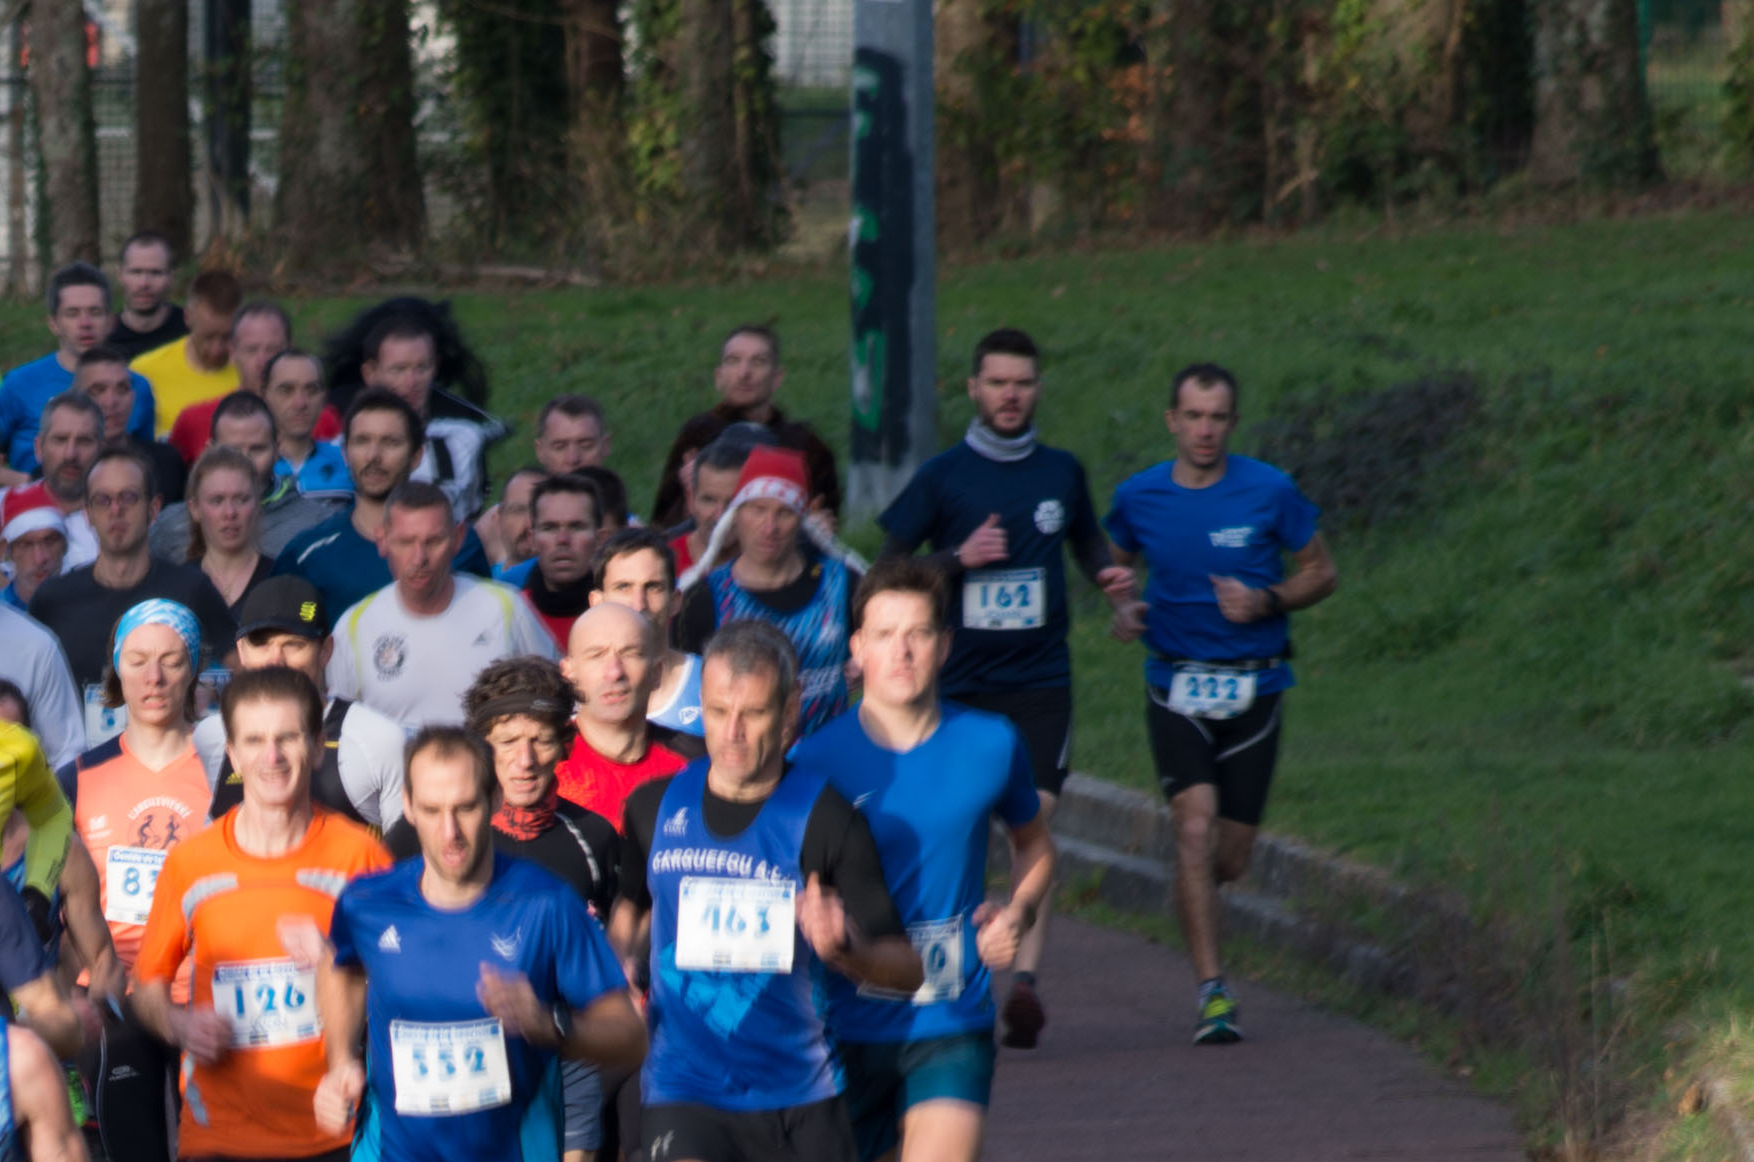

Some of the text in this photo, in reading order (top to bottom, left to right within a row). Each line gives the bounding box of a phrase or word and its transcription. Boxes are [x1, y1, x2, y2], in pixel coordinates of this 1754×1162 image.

[979, 583, 1030, 608] 162
[1186, 676, 1239, 700] 222
[234, 983, 305, 1018] 126
